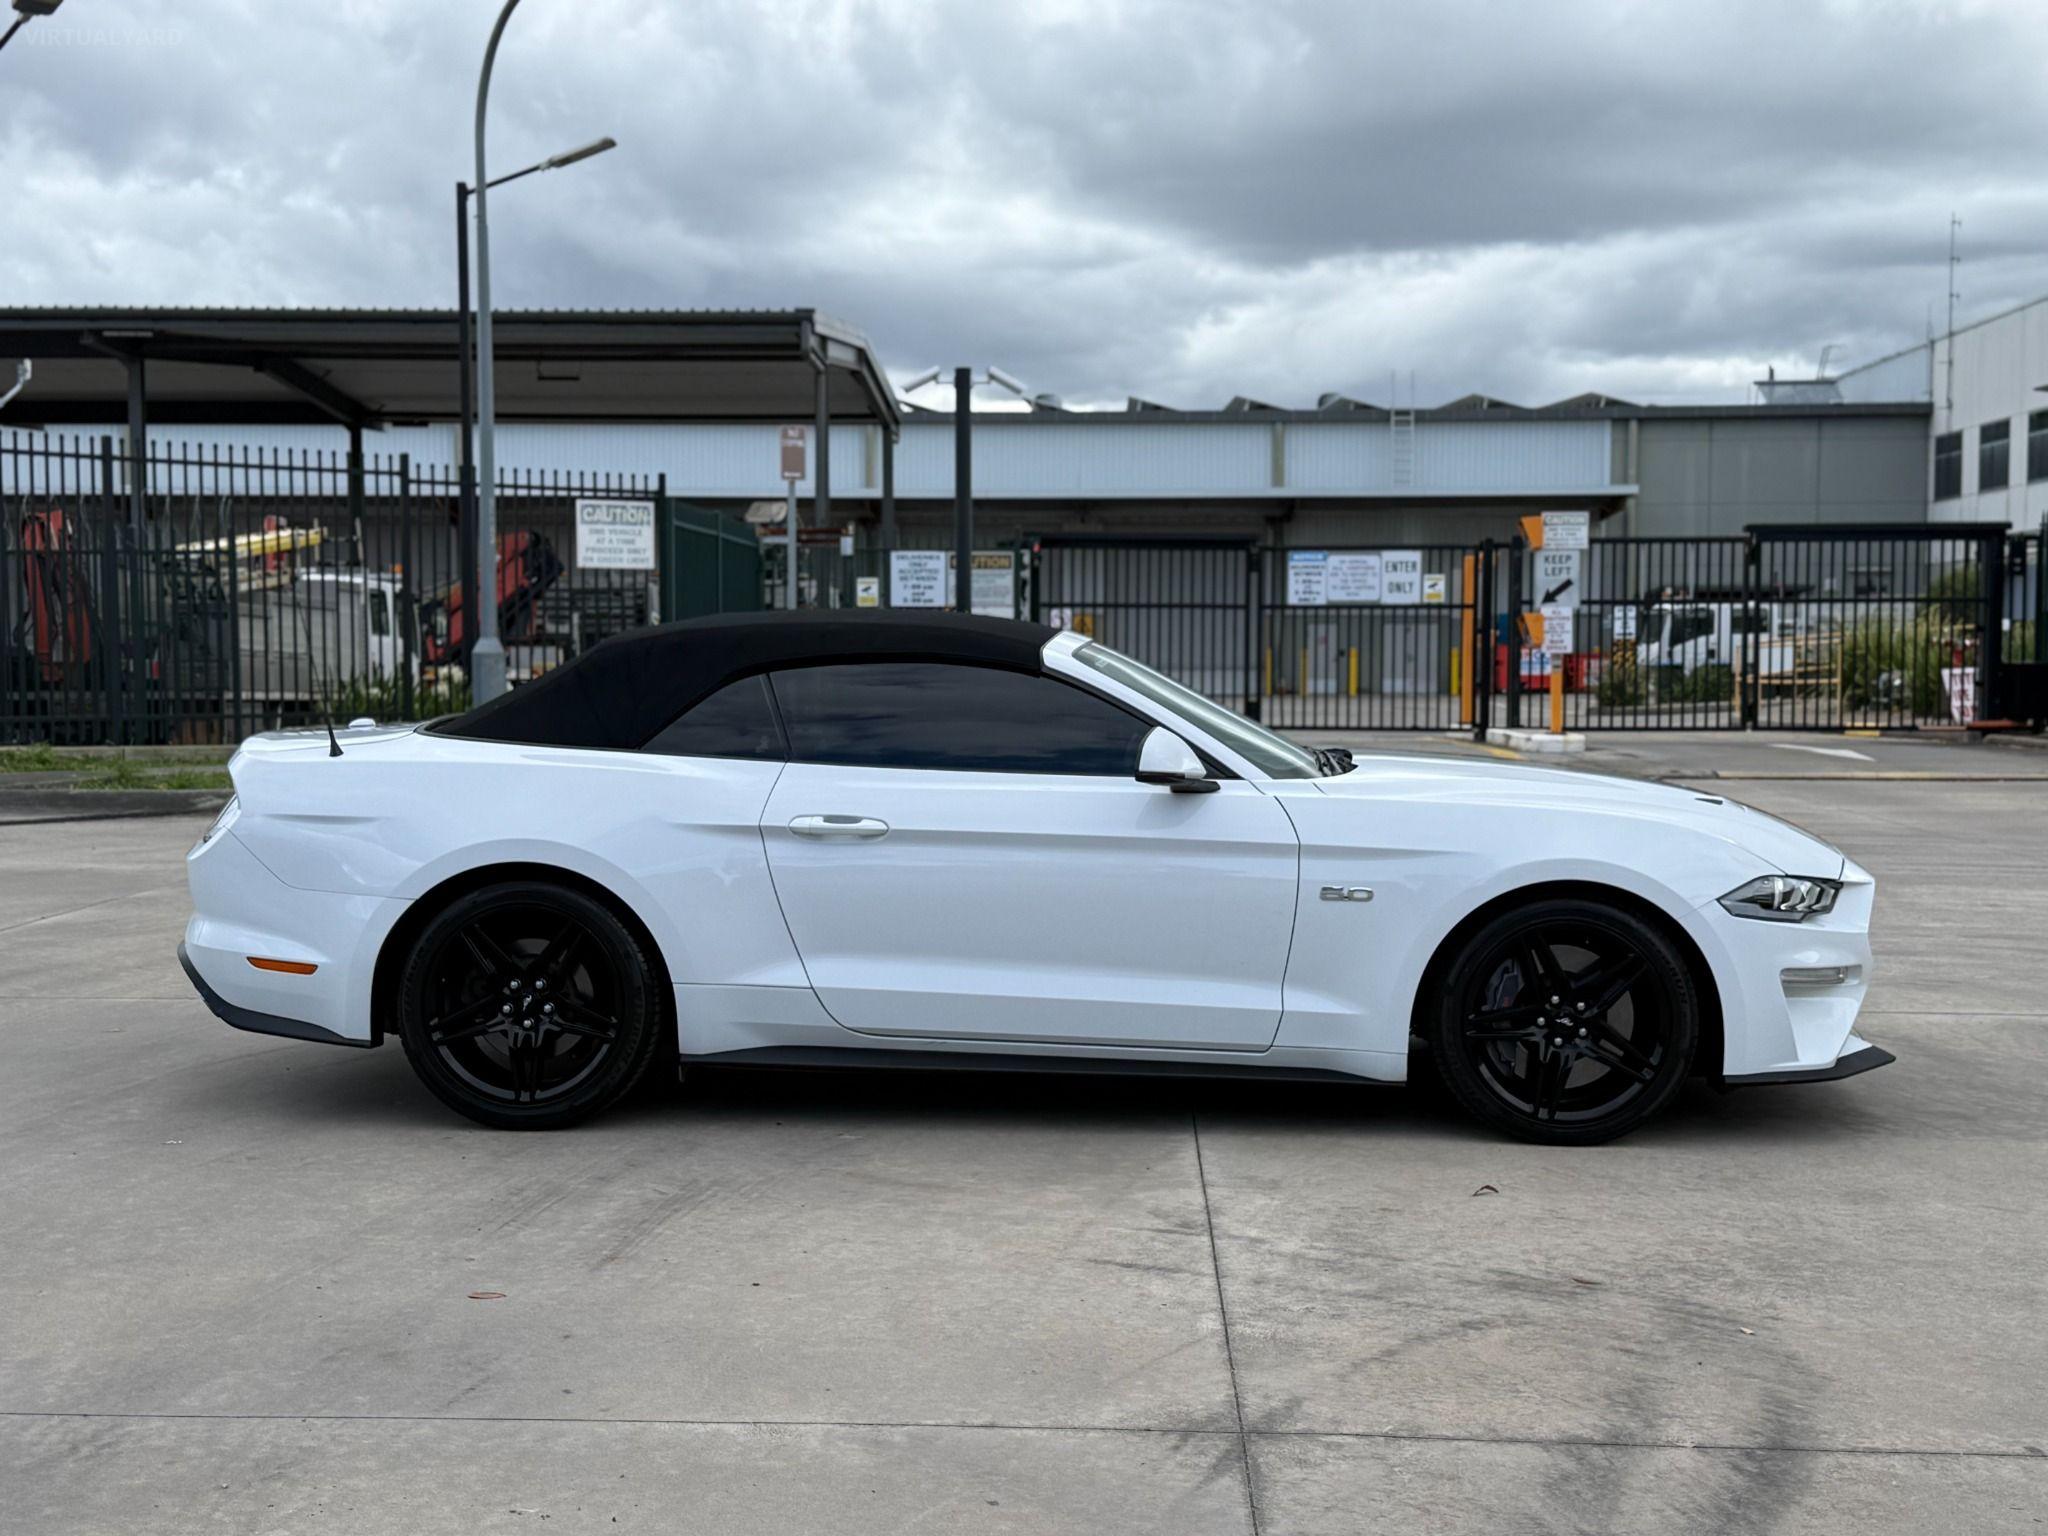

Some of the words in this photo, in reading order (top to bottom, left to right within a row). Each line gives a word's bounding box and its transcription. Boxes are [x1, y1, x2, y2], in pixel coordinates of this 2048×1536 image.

[582, 505, 650, 526] CAUTION
[1543, 555, 1572, 565] KEEP
[1385, 560, 1417, 573] ENTER
[1544, 567, 1571, 577] LEFT
[1388, 582, 1413, 594] ONLY
